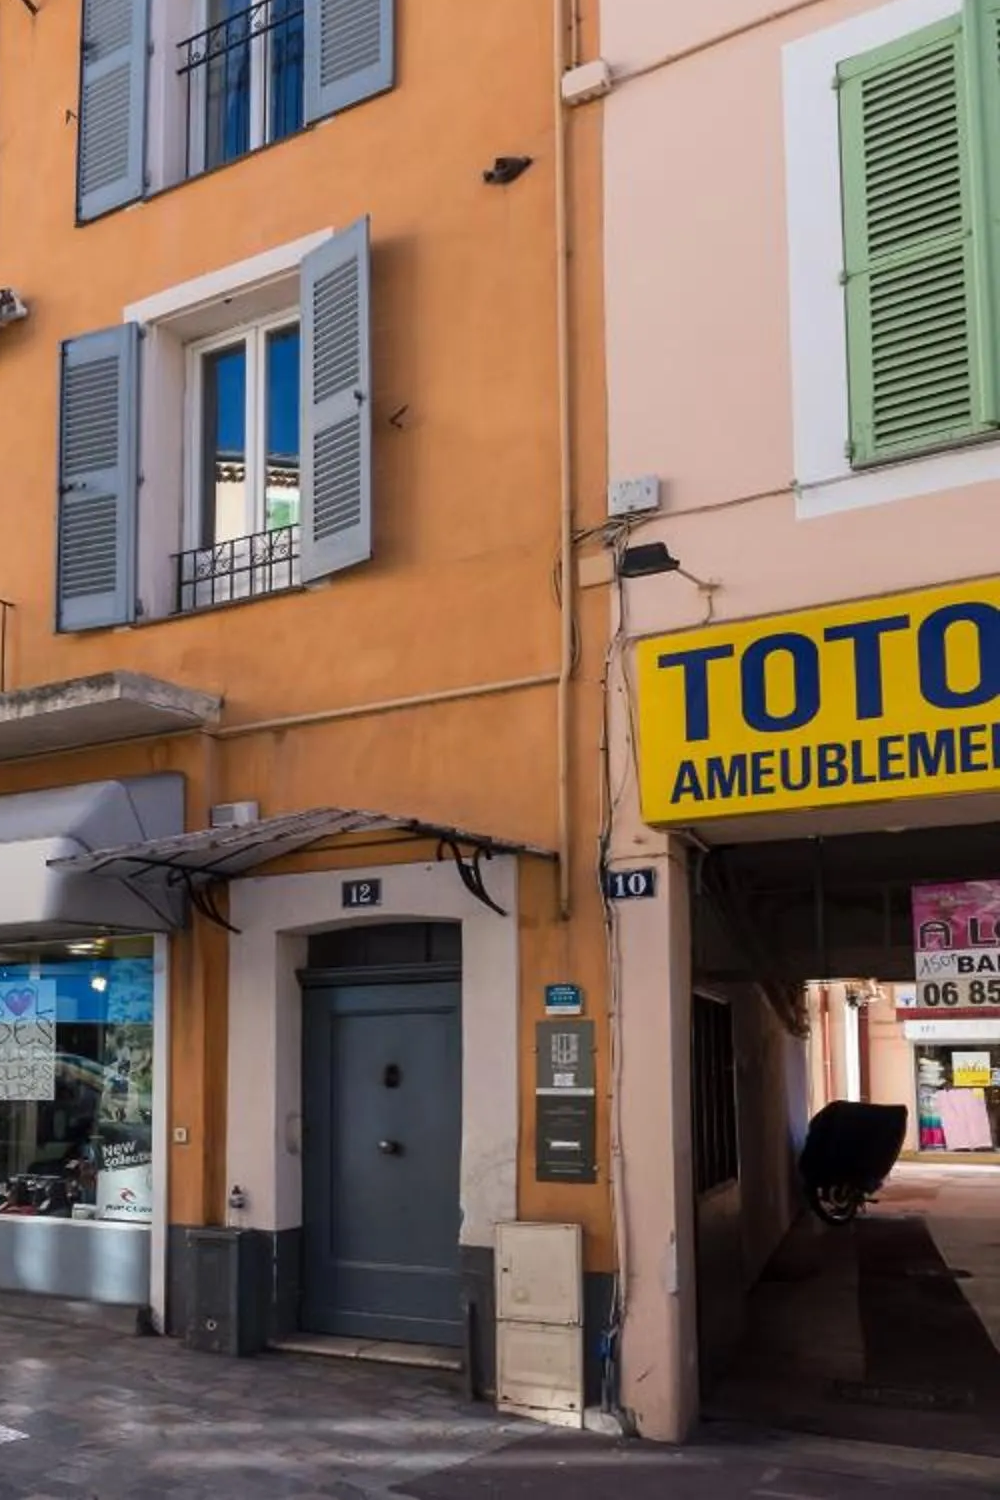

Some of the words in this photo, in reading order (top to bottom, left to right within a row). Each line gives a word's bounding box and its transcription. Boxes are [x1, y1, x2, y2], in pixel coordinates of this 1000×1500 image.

[670, 724, 1000, 804] AMEUBLEME
[351, 883, 370, 903] 12
[615, 873, 646, 897] 10
[919, 920, 951, 949] A
[969, 916, 1000, 945] L
[957, 954, 1000, 974] BA
[923, 981, 959, 1007] 06
[969, 979, 1000, 1005] 85
[102, 1140, 137, 1158] New
